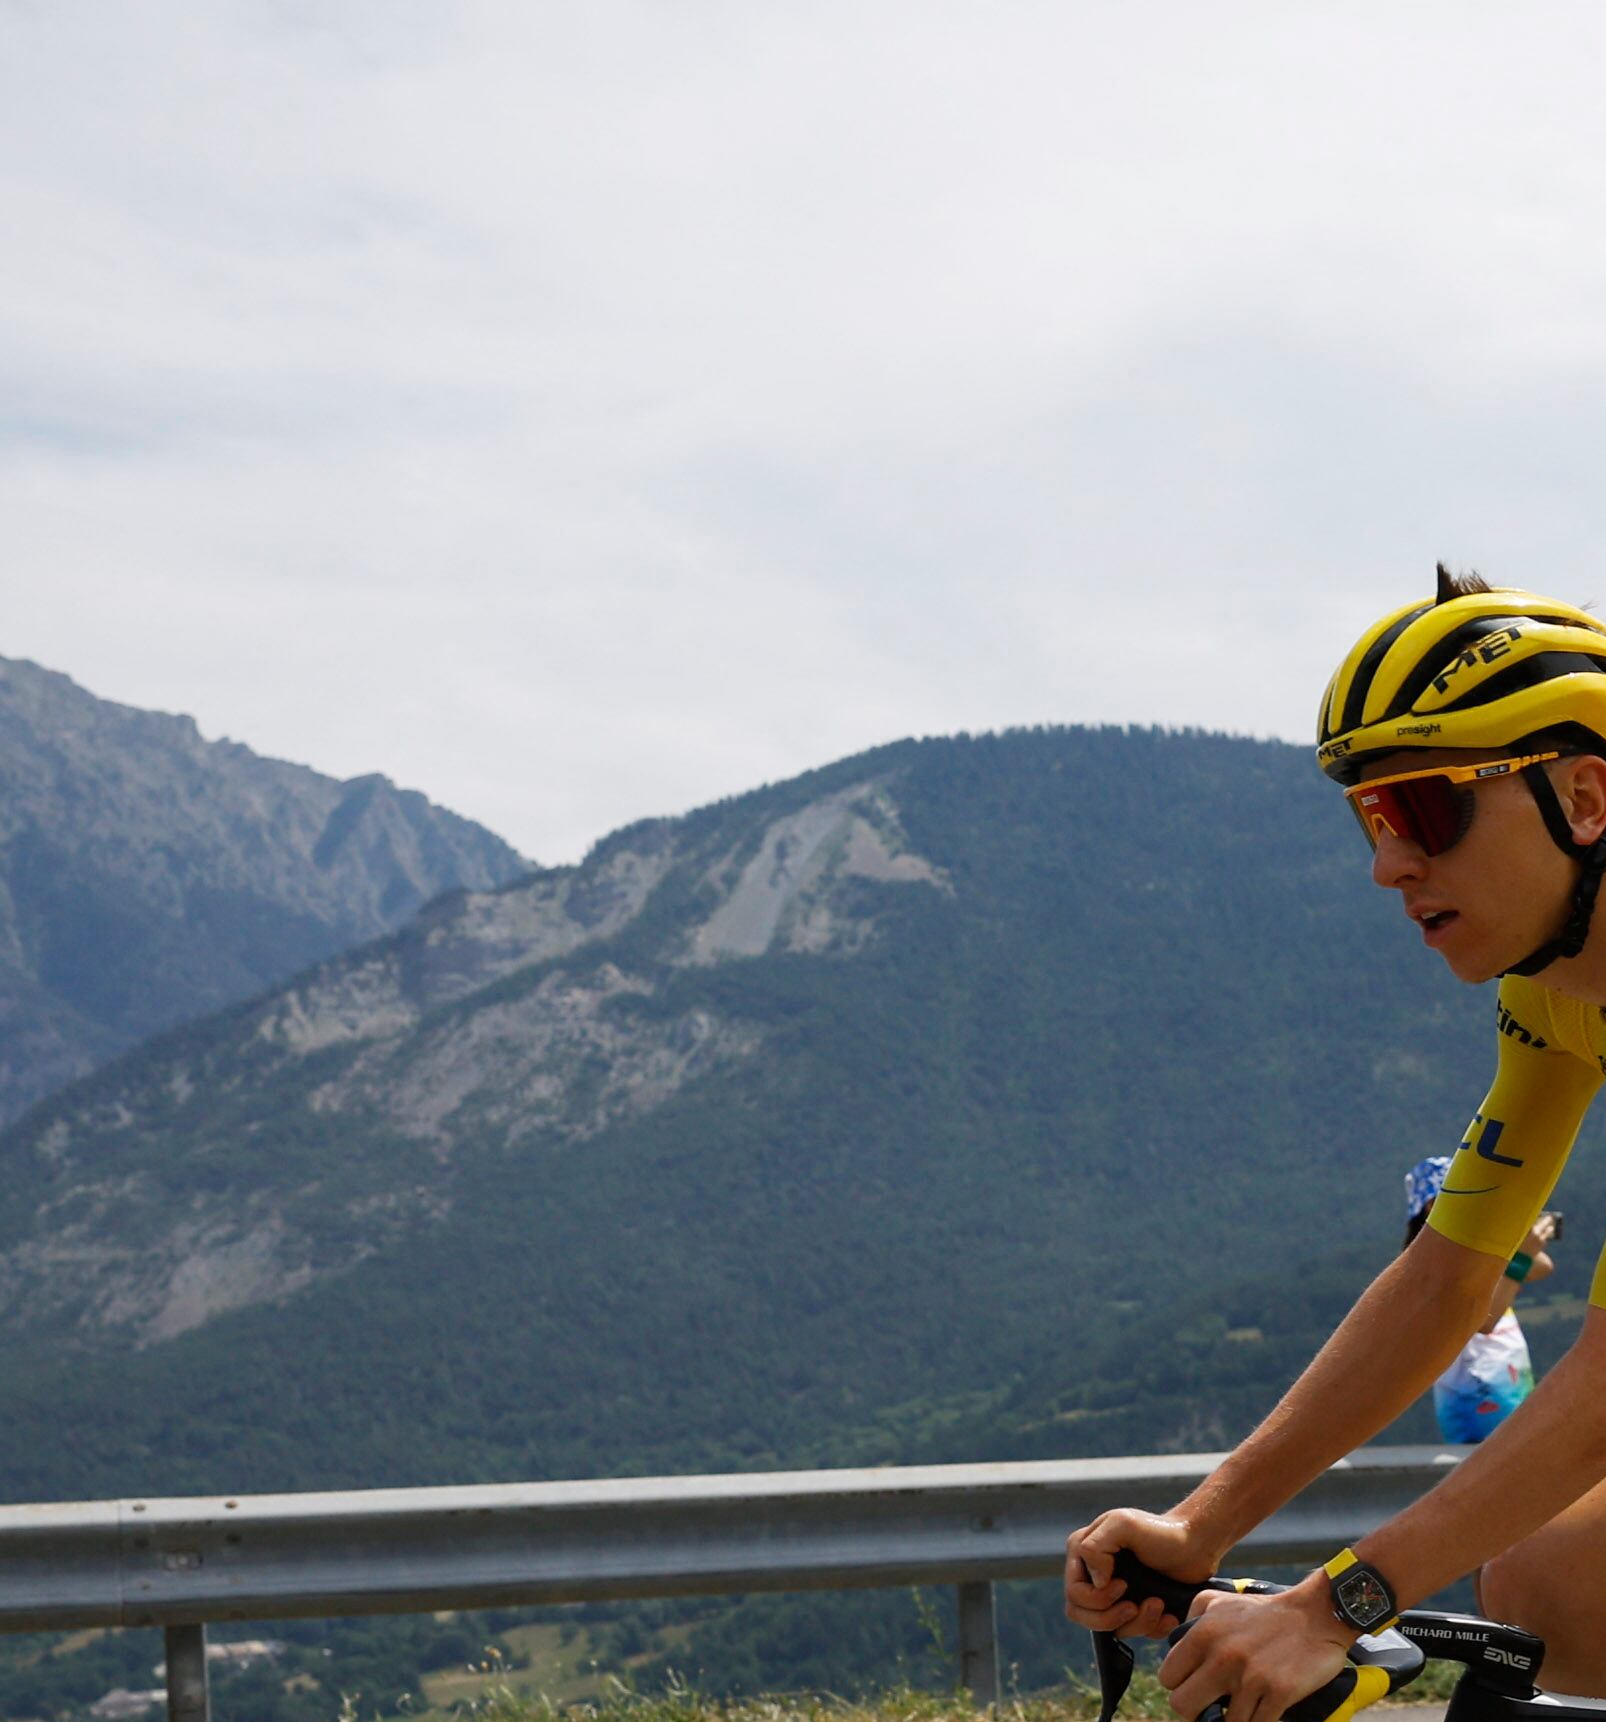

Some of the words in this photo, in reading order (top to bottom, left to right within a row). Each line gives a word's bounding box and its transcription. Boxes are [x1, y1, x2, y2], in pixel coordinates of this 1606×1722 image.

[1431, 623, 1523, 695] MET
[1397, 724, 1442, 737] presight
[1318, 737, 1354, 761] MET
